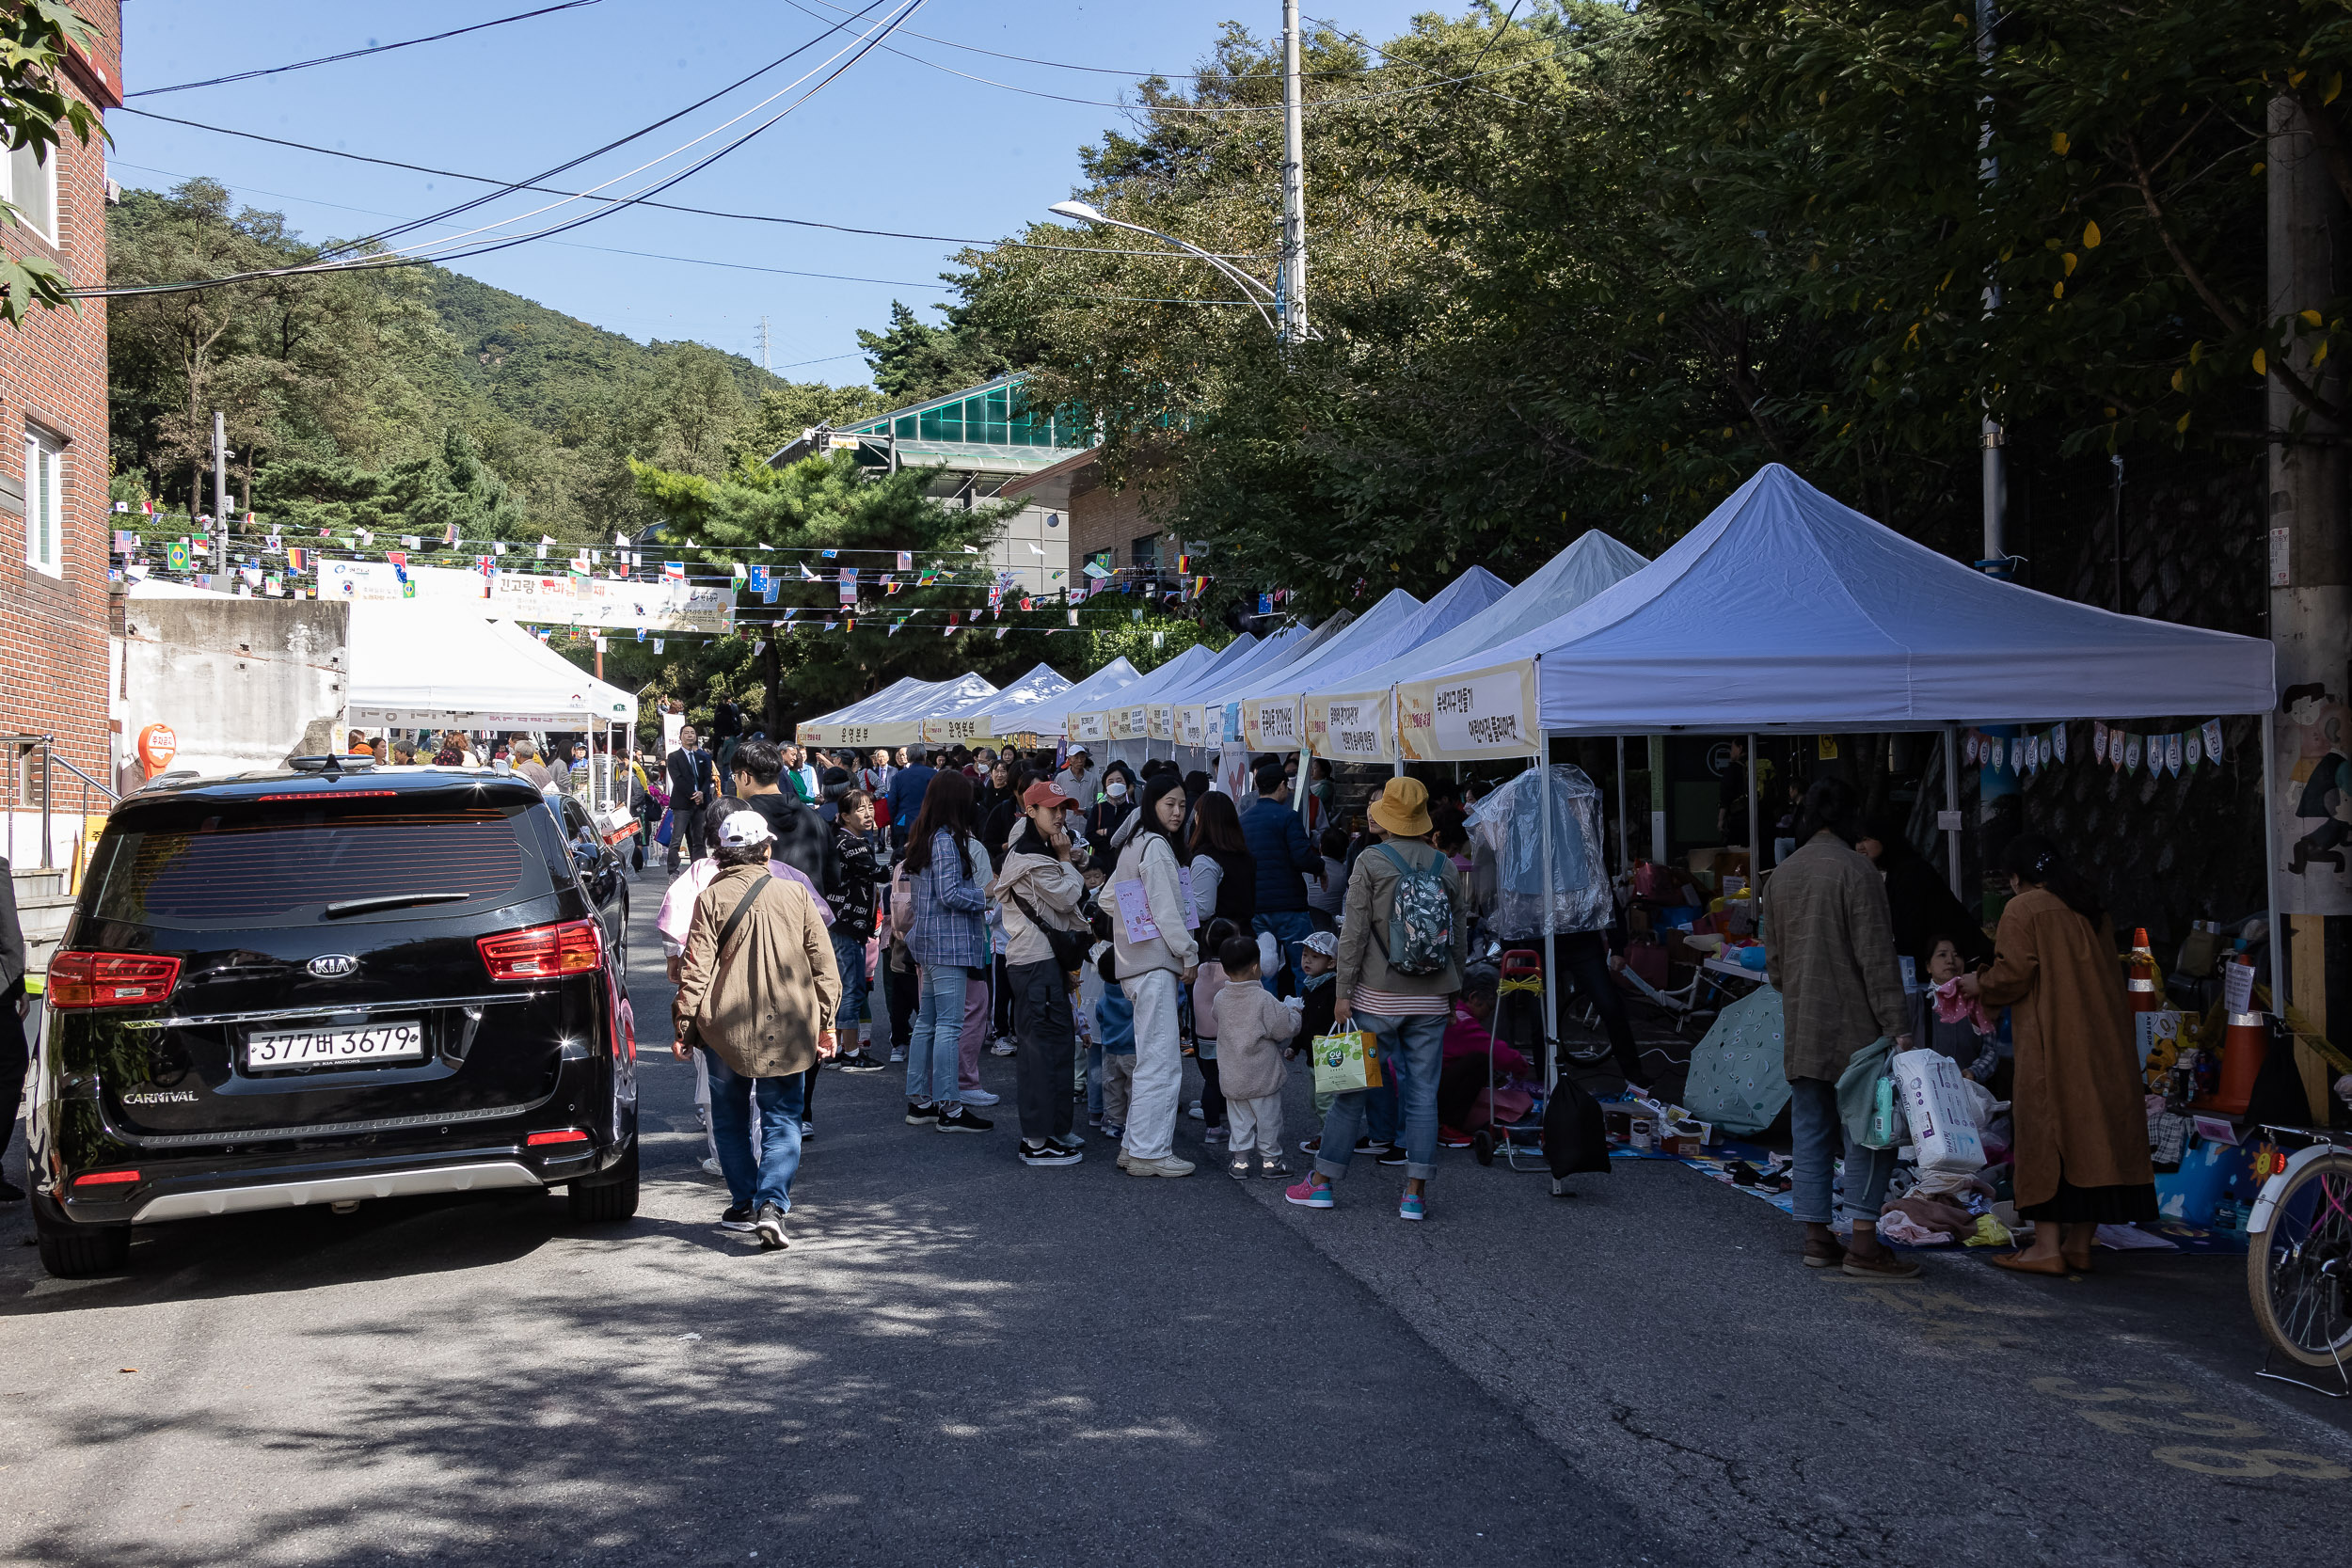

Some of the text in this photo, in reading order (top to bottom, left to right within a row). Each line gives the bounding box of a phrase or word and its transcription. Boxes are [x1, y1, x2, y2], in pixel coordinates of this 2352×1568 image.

[500, 578, 534, 594] 긴고랑
[1437, 690, 1456, 715] 녹색지구
[1457, 687, 1473, 713] 만들기
[841, 727, 869, 743] 운영본부
[948, 721, 976, 738] 운영본부
[1468, 714, 1518, 744] 어린이집 플리마켓
[152, 736, 173, 746] 주차금지
[314, 958, 350, 974] KIA
[260, 1026, 410, 1060] 377버 3679
[123, 1090, 199, 1105] CARNIVAL
